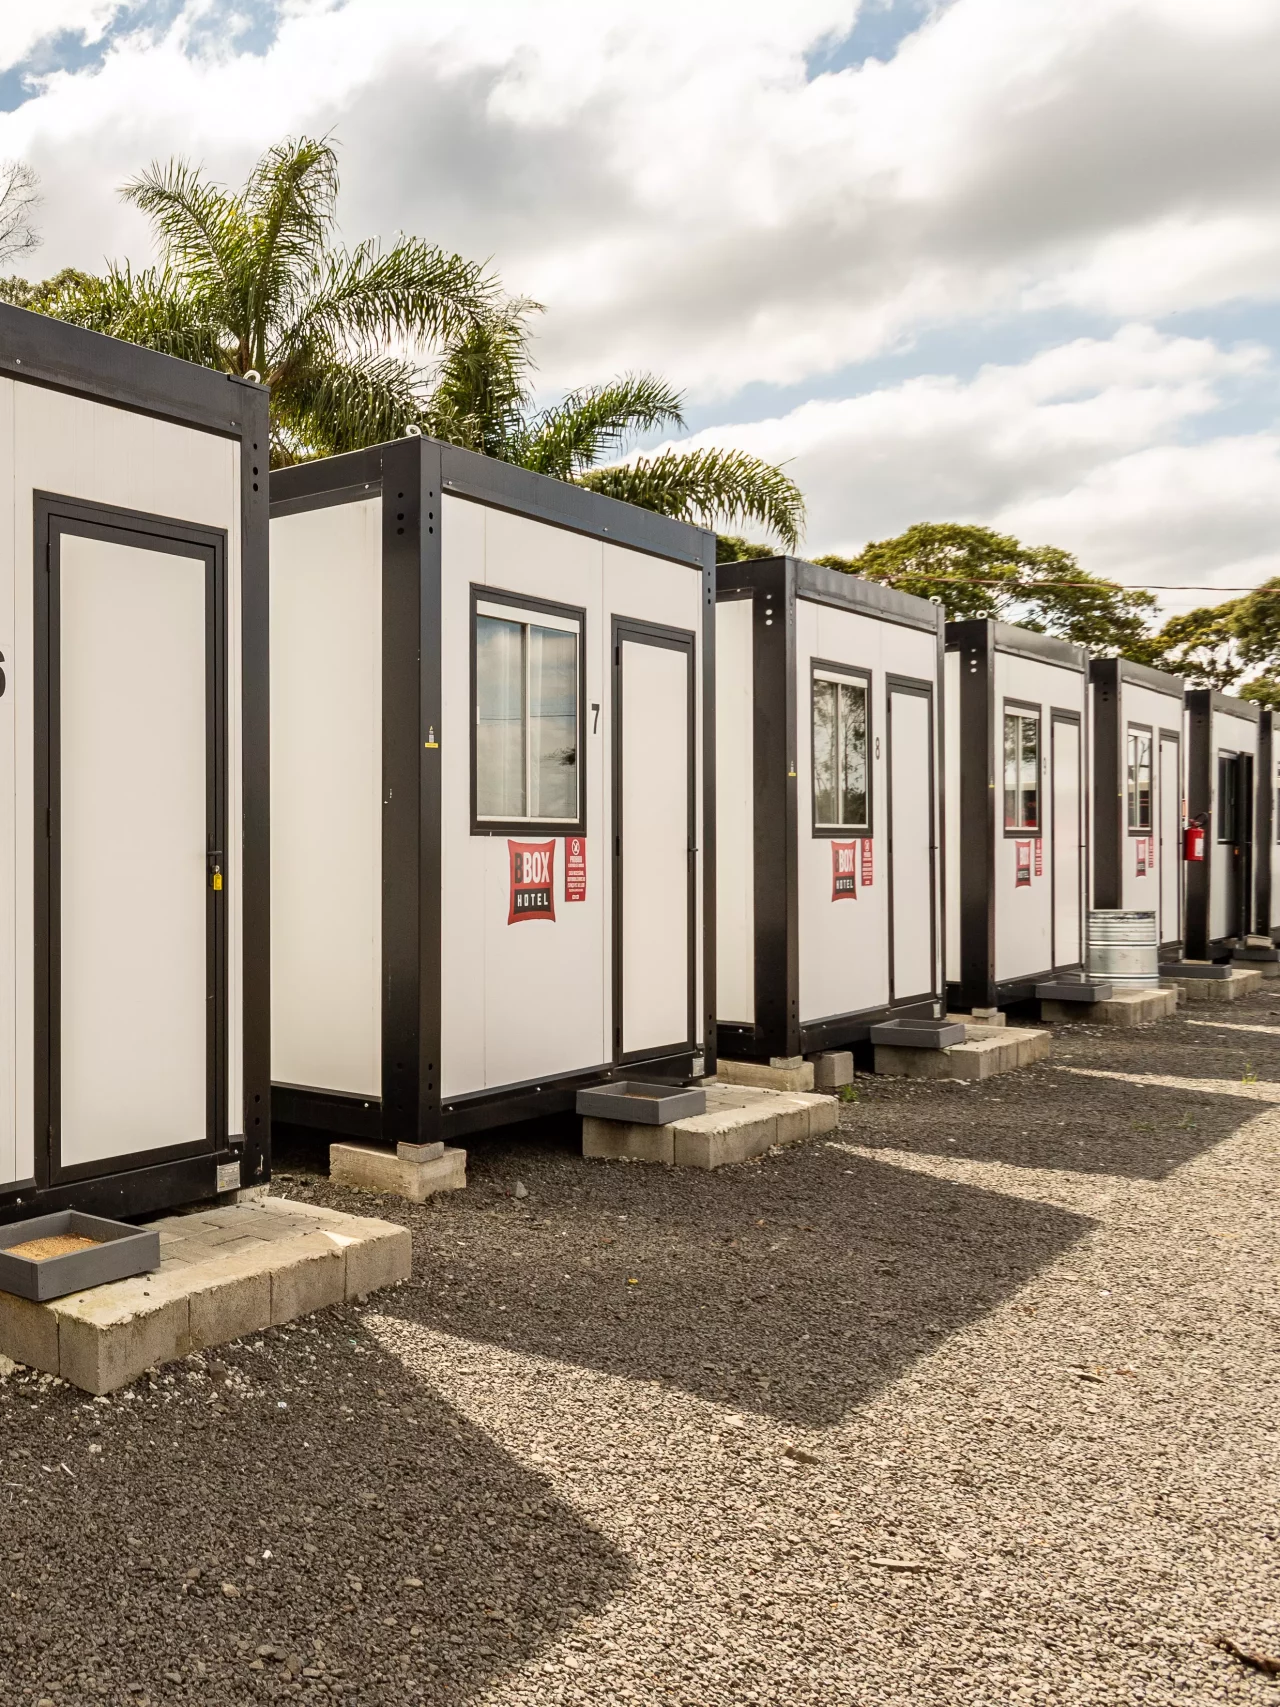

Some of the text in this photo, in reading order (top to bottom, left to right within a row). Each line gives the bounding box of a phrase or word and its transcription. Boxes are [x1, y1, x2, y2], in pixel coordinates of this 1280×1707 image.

[591, 703, 600, 735] 7
[875, 736, 880, 761] 8
[514, 851, 550, 884] BBOX
[836, 879, 854, 890] HOTEL
[517, 892, 548, 907] HOTEL
